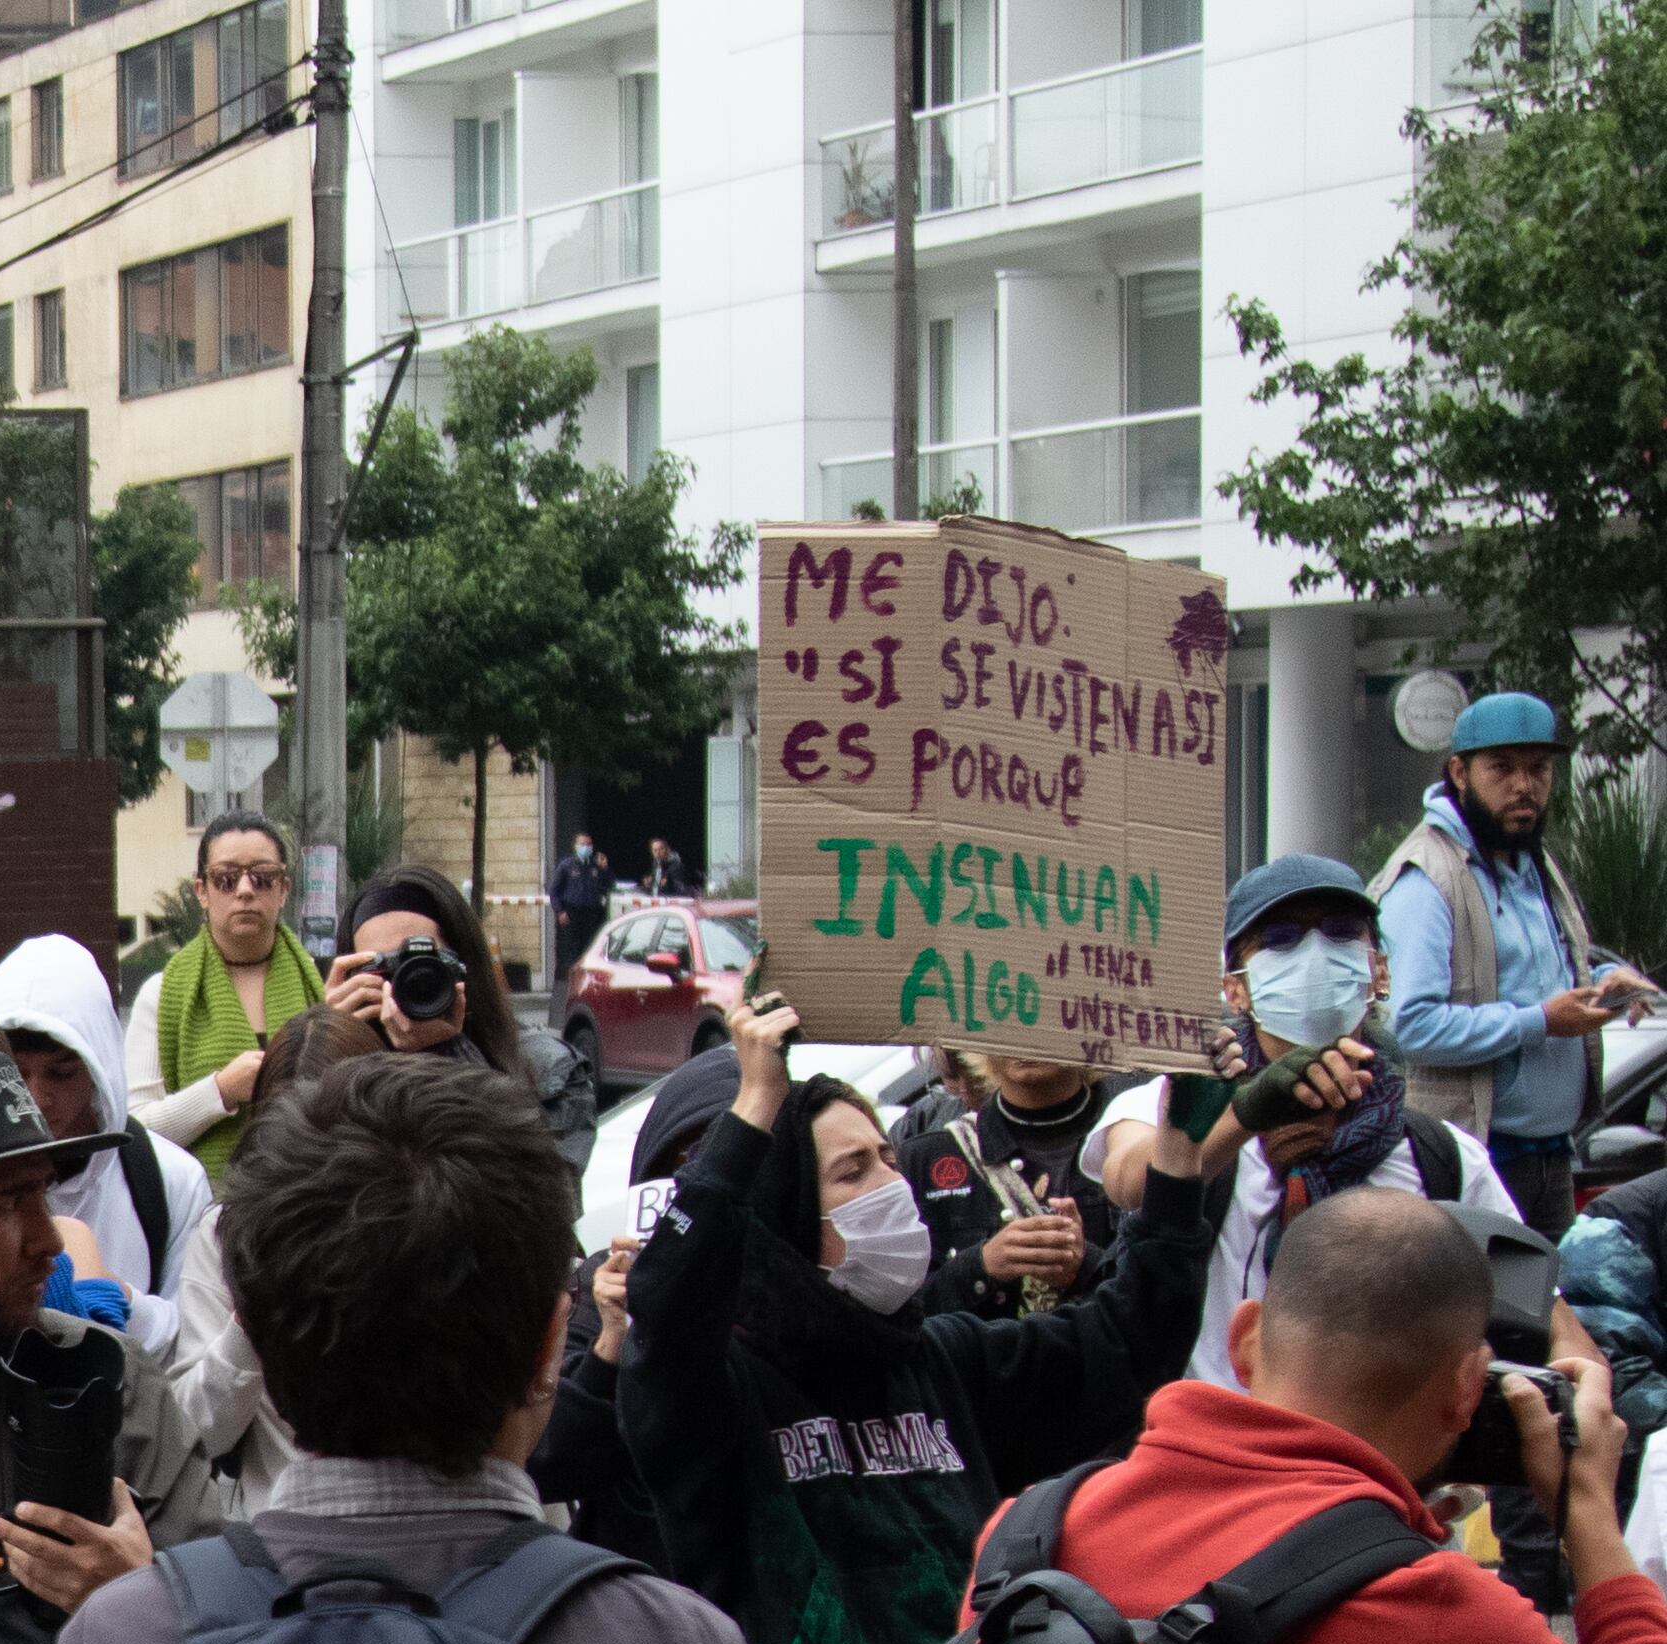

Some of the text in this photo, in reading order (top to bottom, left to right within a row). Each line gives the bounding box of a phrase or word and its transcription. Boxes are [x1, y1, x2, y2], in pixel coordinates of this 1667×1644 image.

[783, 540, 1077, 648] ME DIJO:
[779, 719, 878, 784] ES
[940, 636, 998, 711] SE
[1007, 656, 1142, 757] VISTEN
[1151, 686, 1221, 766] ASI
[812, 836, 1164, 947] INSINUAN
